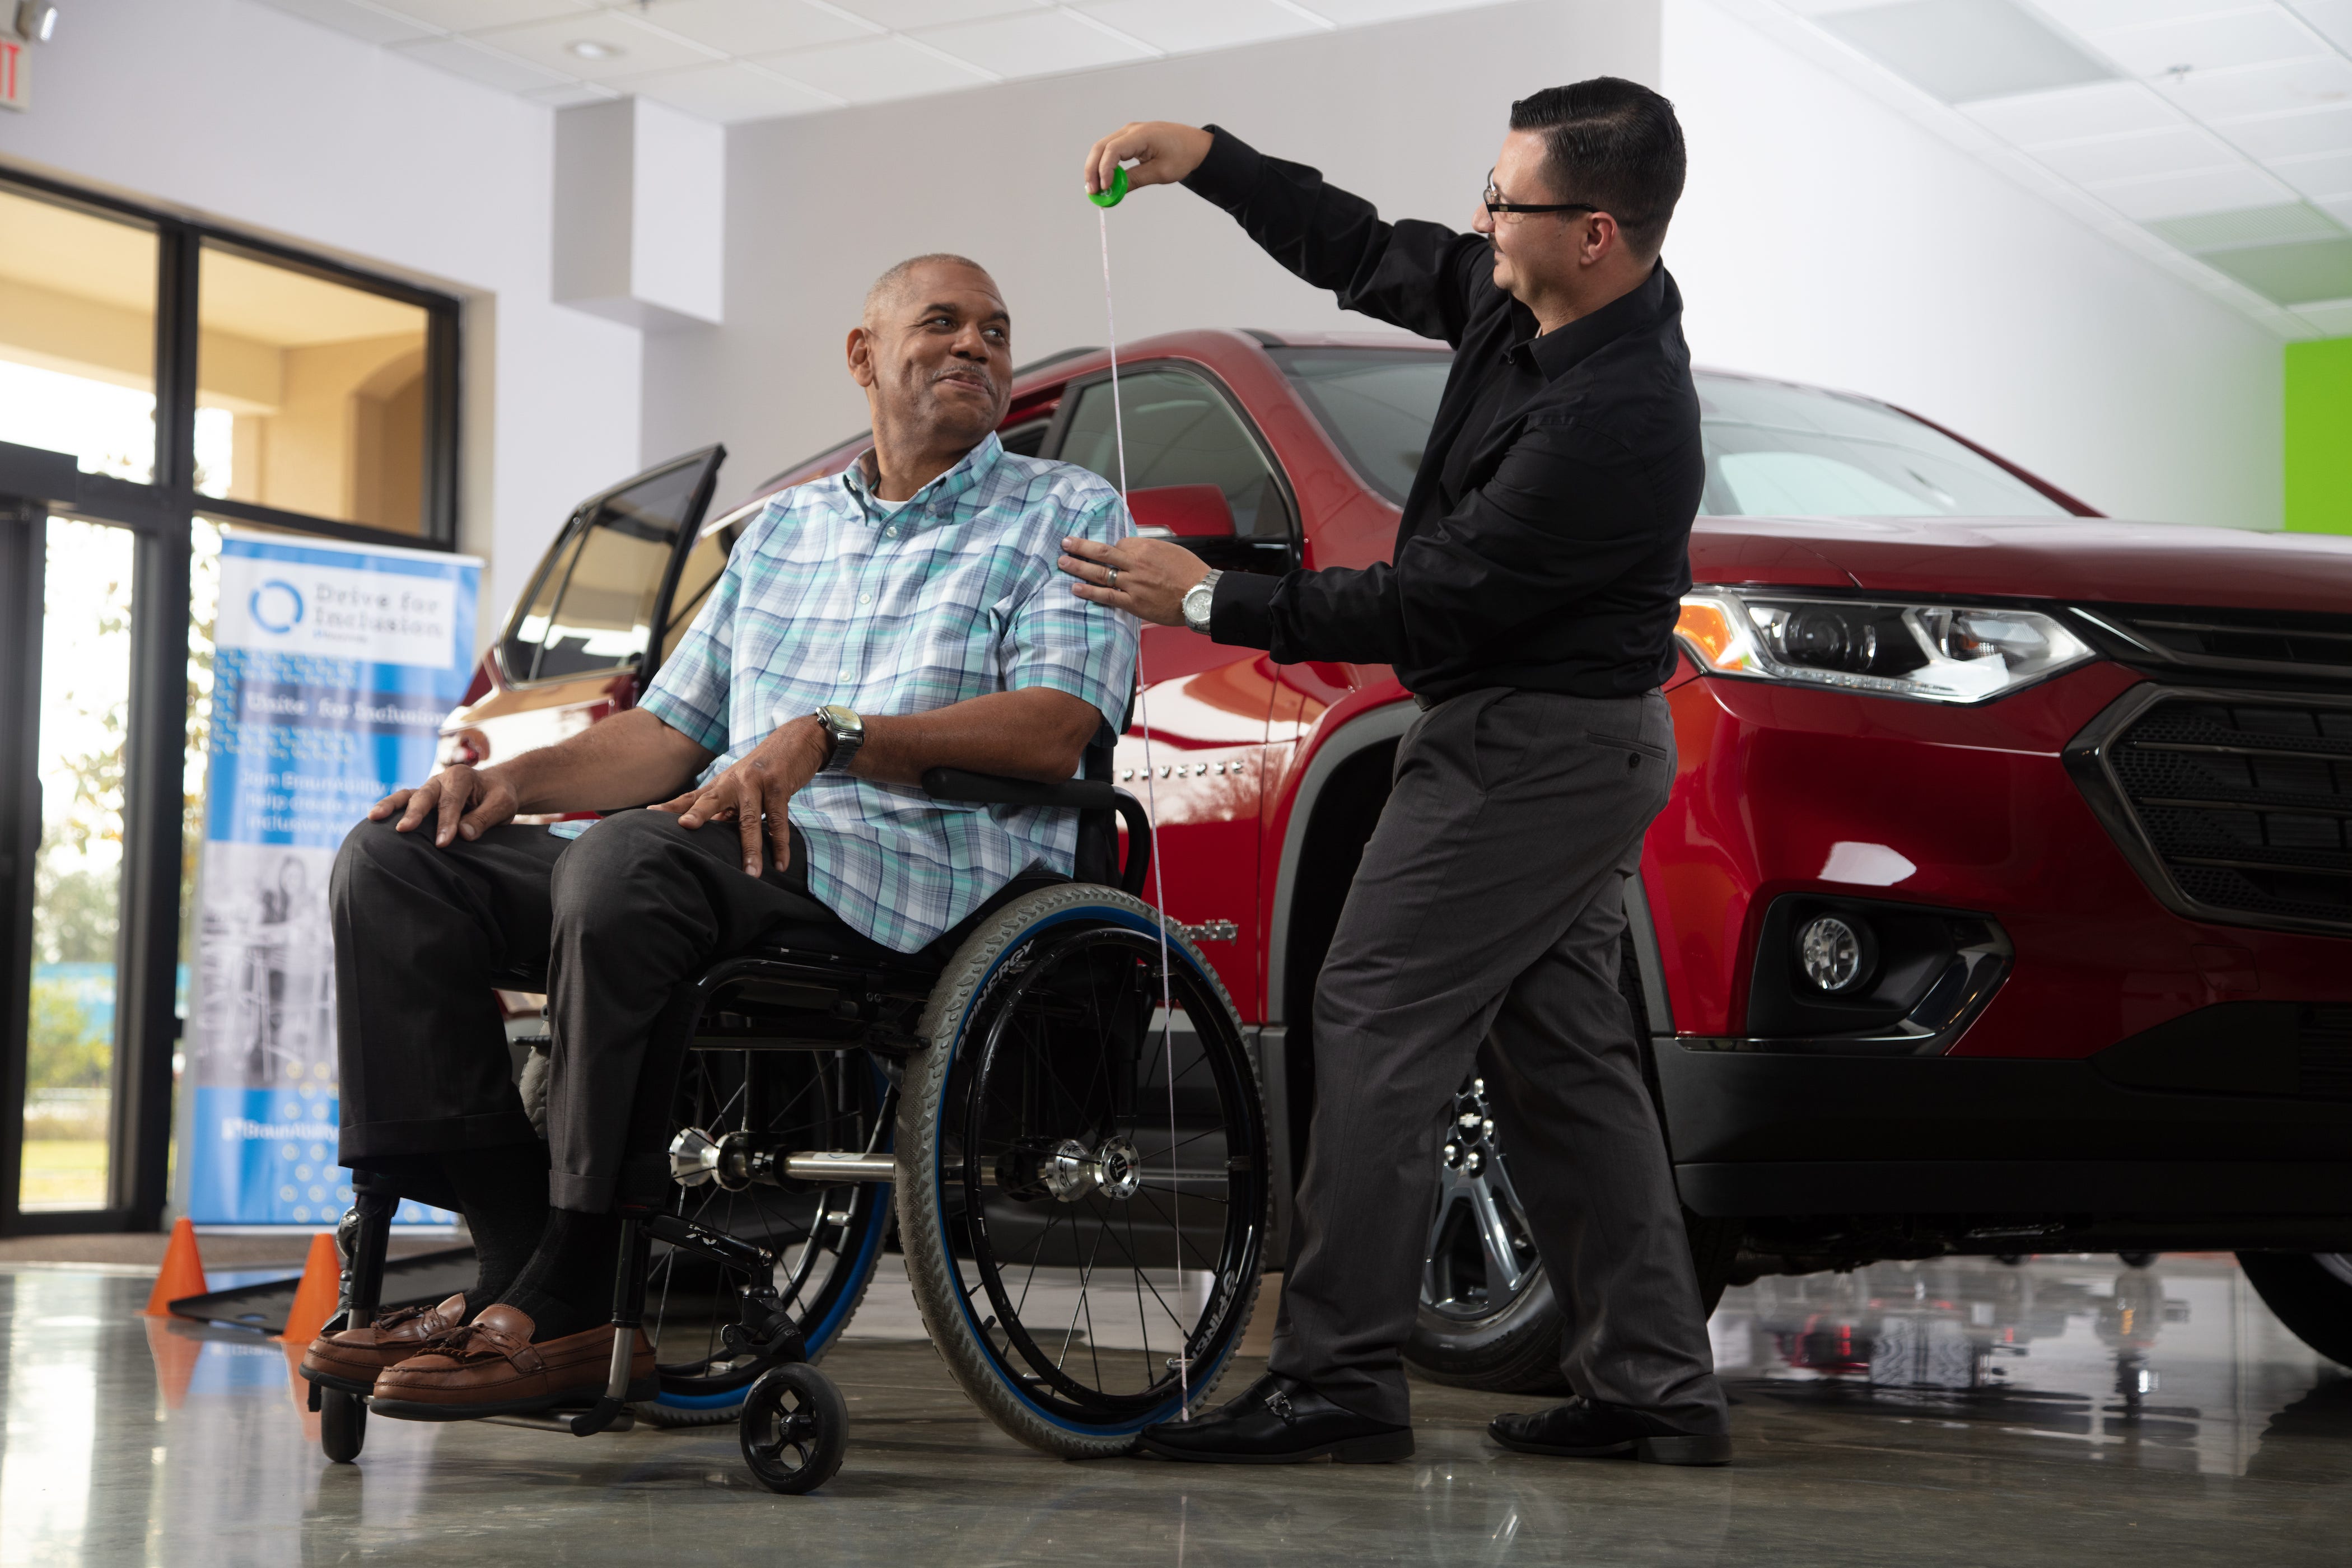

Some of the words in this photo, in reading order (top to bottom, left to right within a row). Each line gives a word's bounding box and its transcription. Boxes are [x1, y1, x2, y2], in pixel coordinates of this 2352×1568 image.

[245, 690, 308, 716] Unite
[318, 698, 349, 720] for
[354, 701, 447, 727] Inclusion
[1113, 759, 1245, 782] RAVERSE
